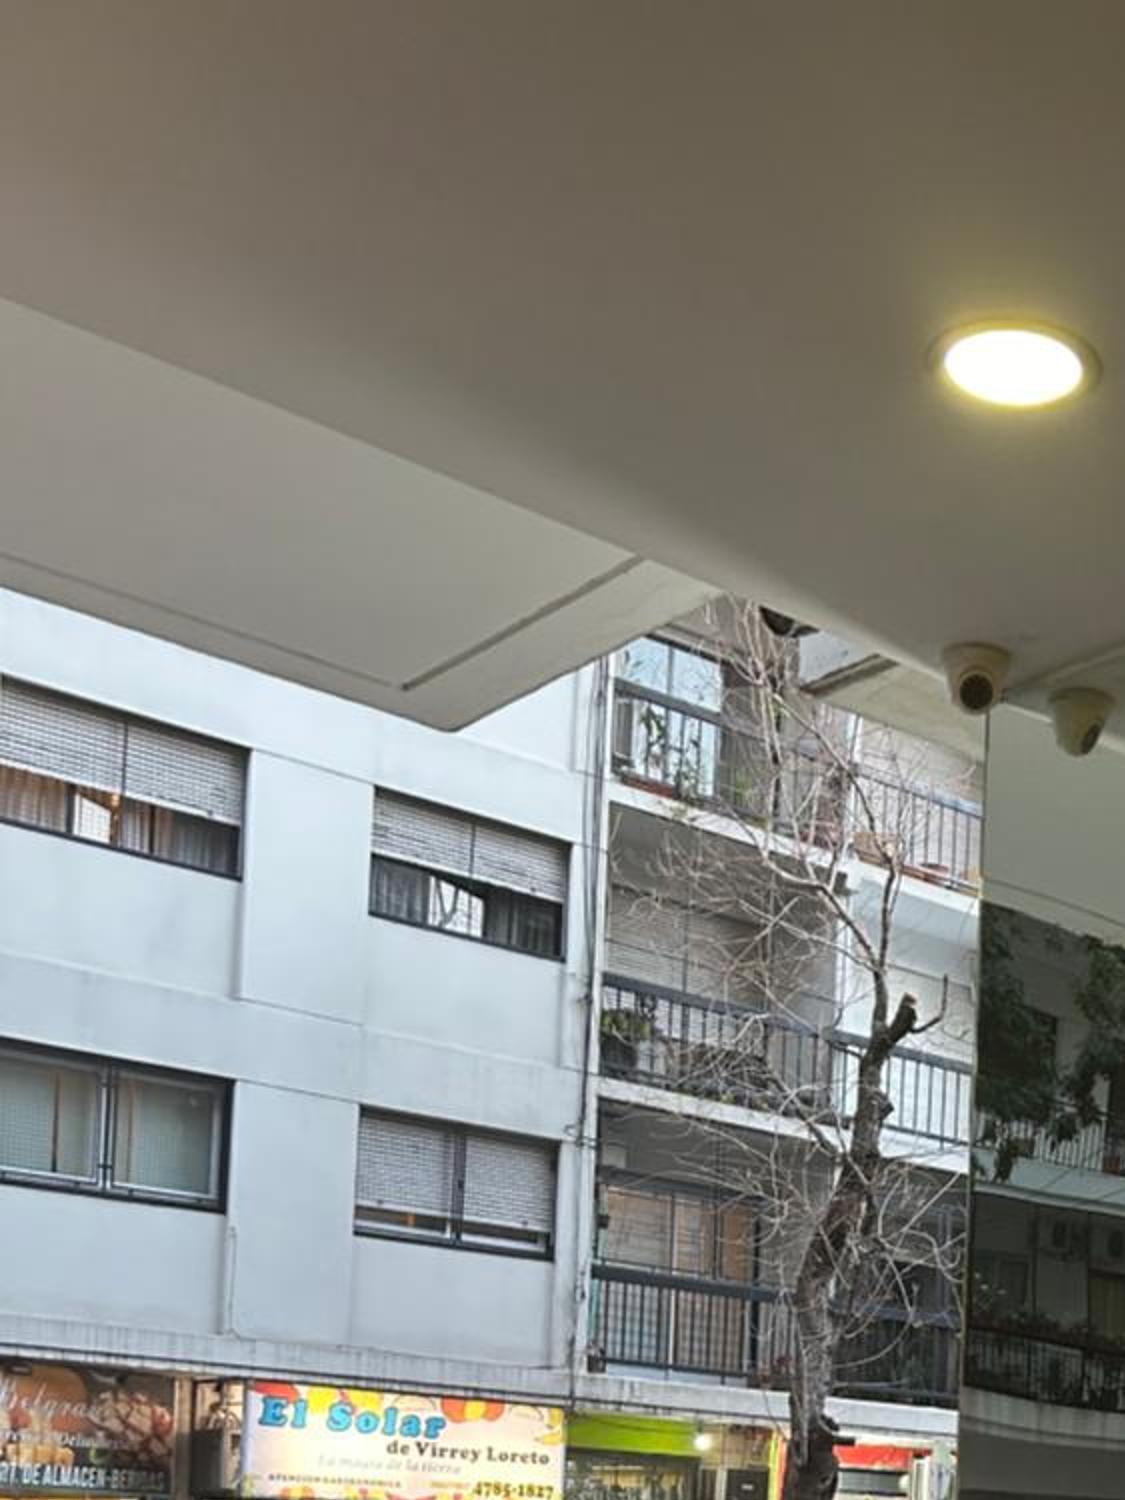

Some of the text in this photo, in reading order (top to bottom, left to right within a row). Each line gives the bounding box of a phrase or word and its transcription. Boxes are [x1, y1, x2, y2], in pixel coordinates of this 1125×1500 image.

[258, 1394, 447, 1440] El Solar
[386, 1440, 550, 1465] de Virrey Loreto
